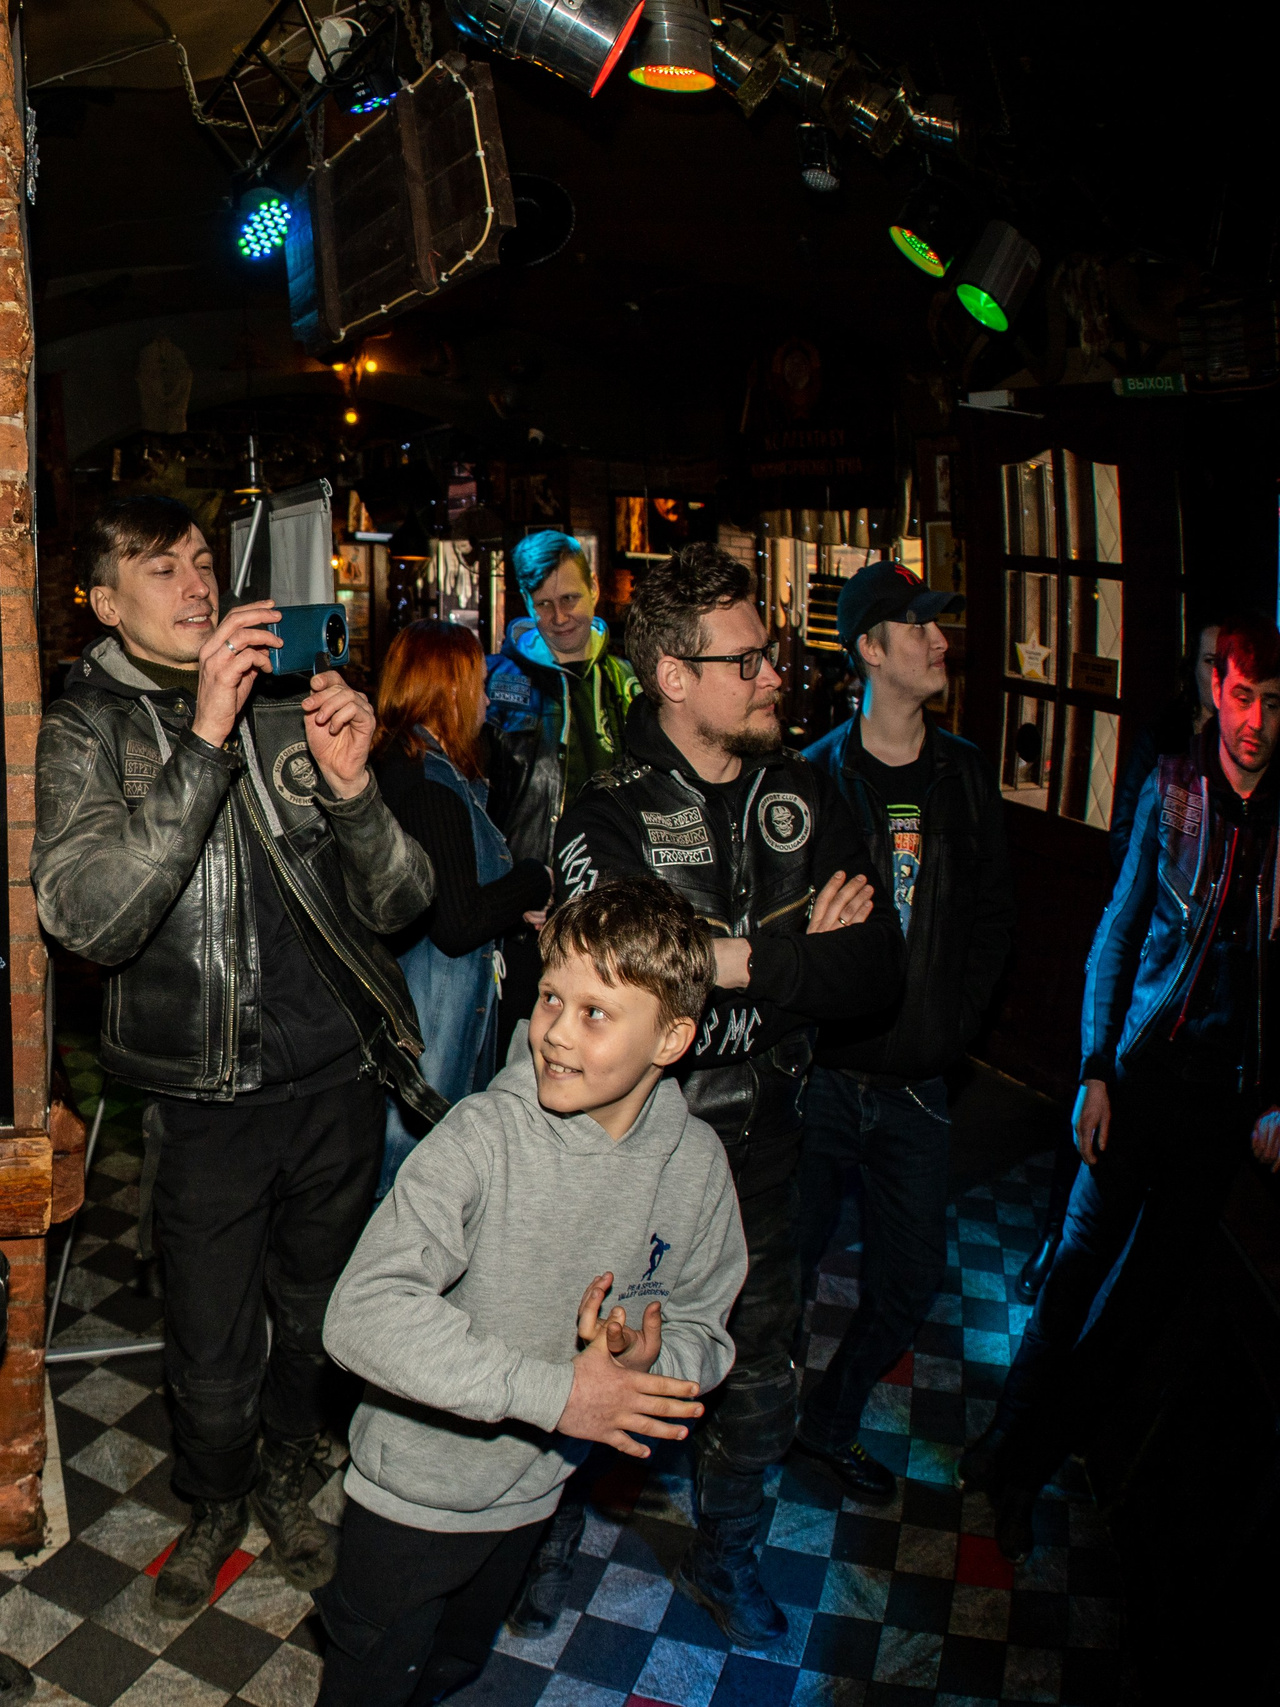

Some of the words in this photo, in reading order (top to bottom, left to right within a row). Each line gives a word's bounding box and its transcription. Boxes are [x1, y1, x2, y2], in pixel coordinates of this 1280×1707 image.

[1127, 376, 1174, 391] ВЫХОД
[275, 746, 296, 773] SUPPORT
[659, 850, 705, 863] PROSPECT
